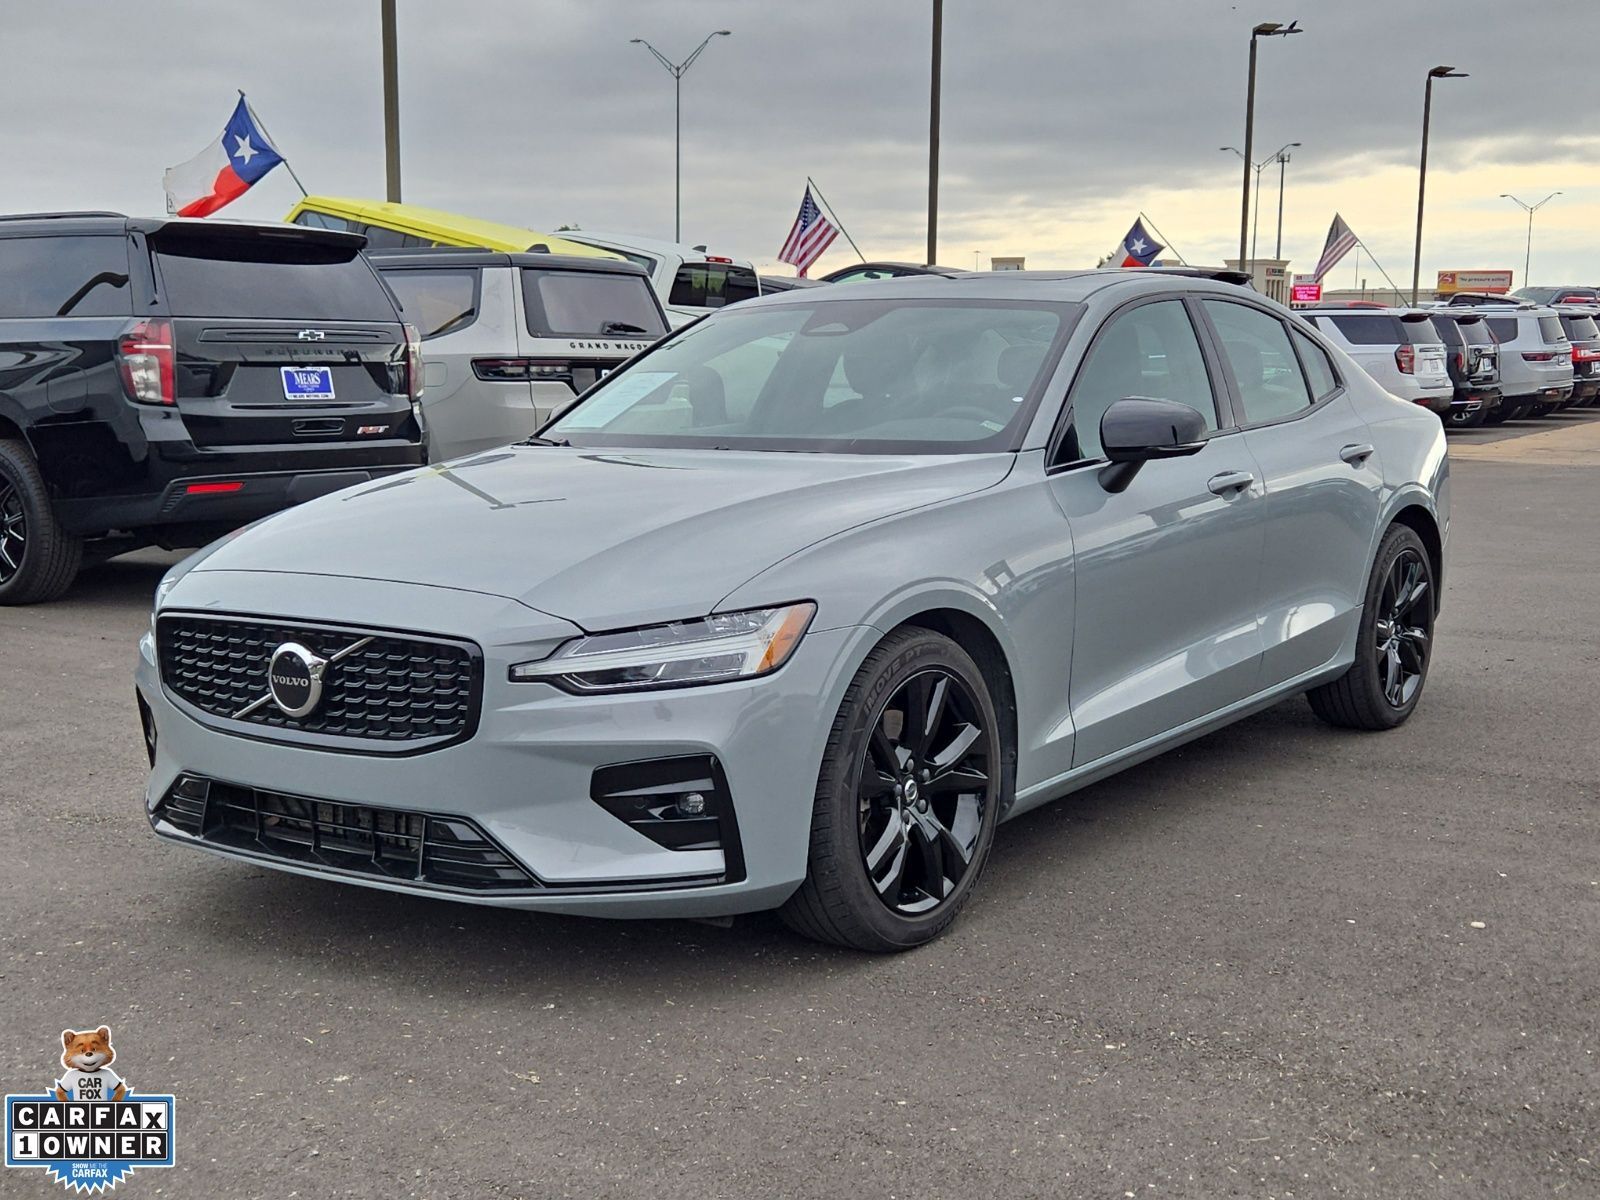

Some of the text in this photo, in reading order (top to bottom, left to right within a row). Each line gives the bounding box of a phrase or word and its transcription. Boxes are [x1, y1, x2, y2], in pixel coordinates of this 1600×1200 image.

[570, 342, 609, 350] GRAND
[294, 371, 321, 385] MEARS
[272, 675, 309, 687] VOLVO
